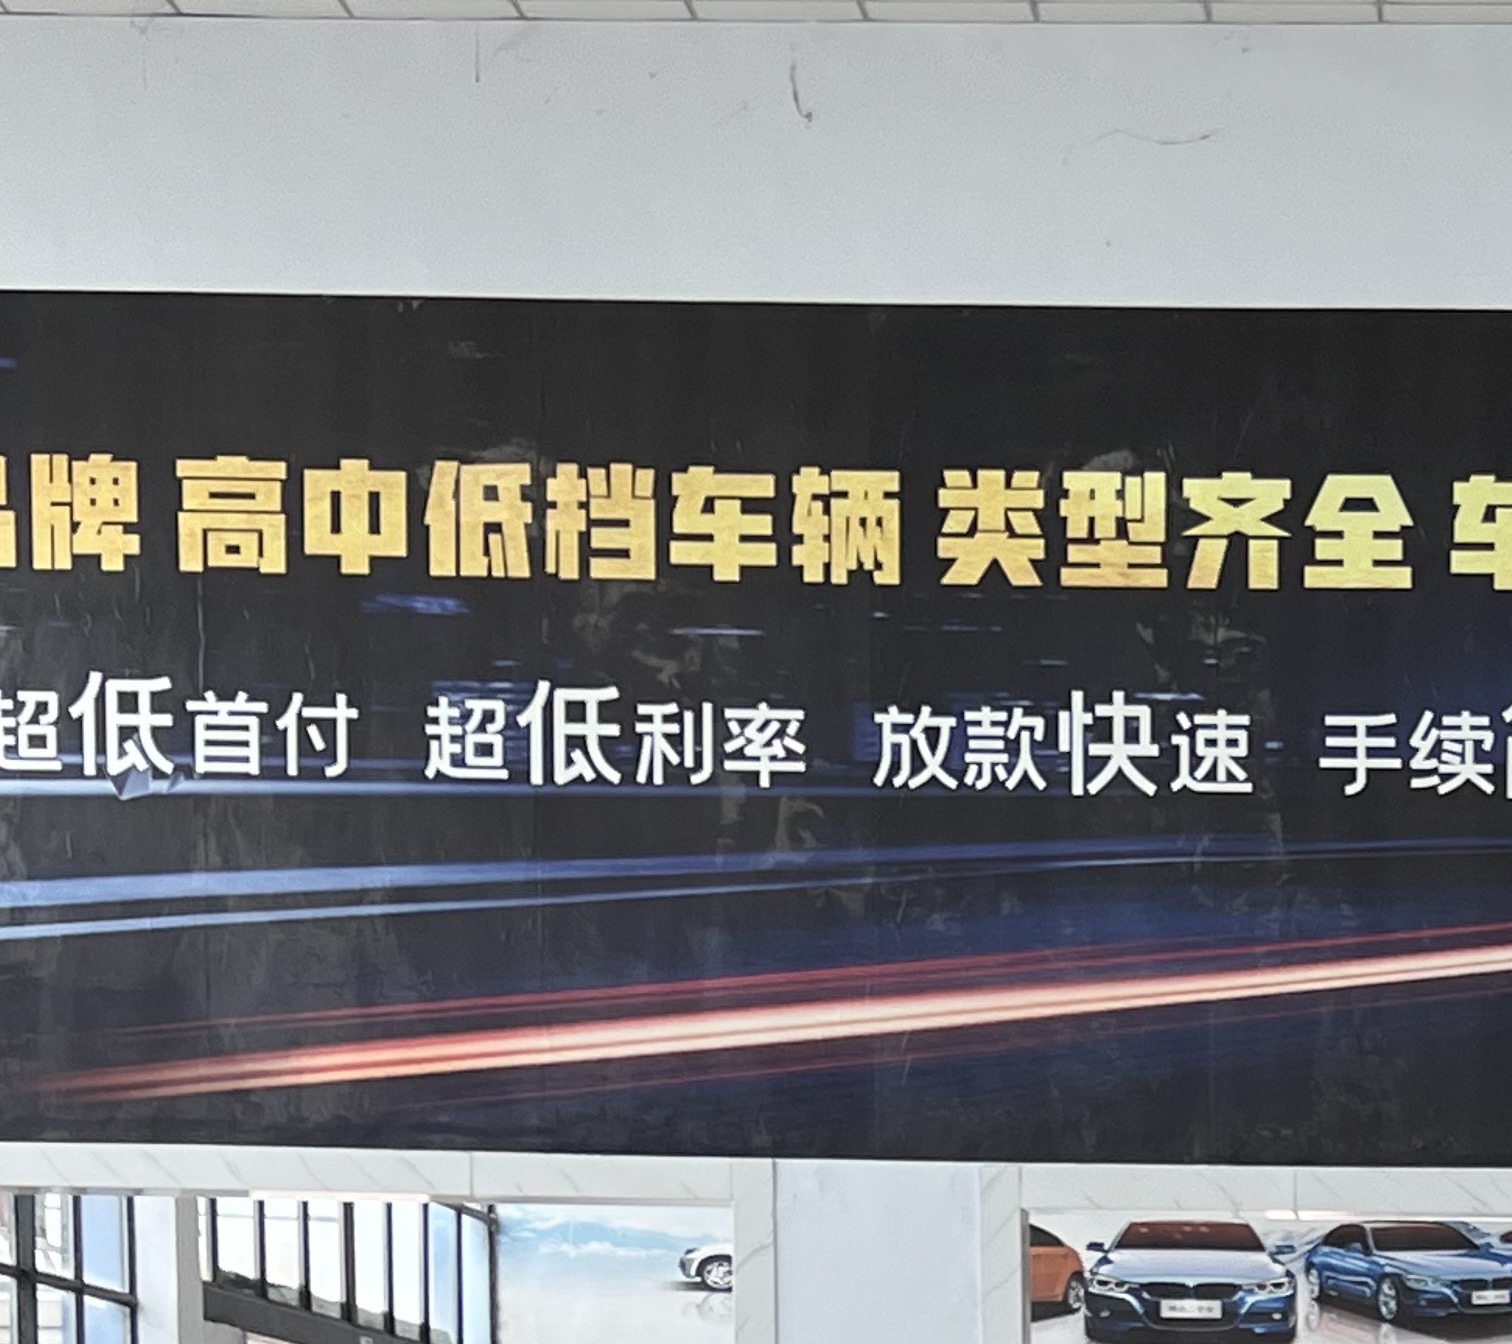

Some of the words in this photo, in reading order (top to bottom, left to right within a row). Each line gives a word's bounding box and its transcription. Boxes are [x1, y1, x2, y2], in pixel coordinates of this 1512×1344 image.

[0, 452, 141, 572] 牌
[175, 454, 902, 586] 高中低档车辆
[936, 468, 1415, 590] 类型齐全
[0, 669, 360, 780] 超低首付
[423, 679, 807, 788] 超低利率
[872, 689, 1254, 798] 放款快速
